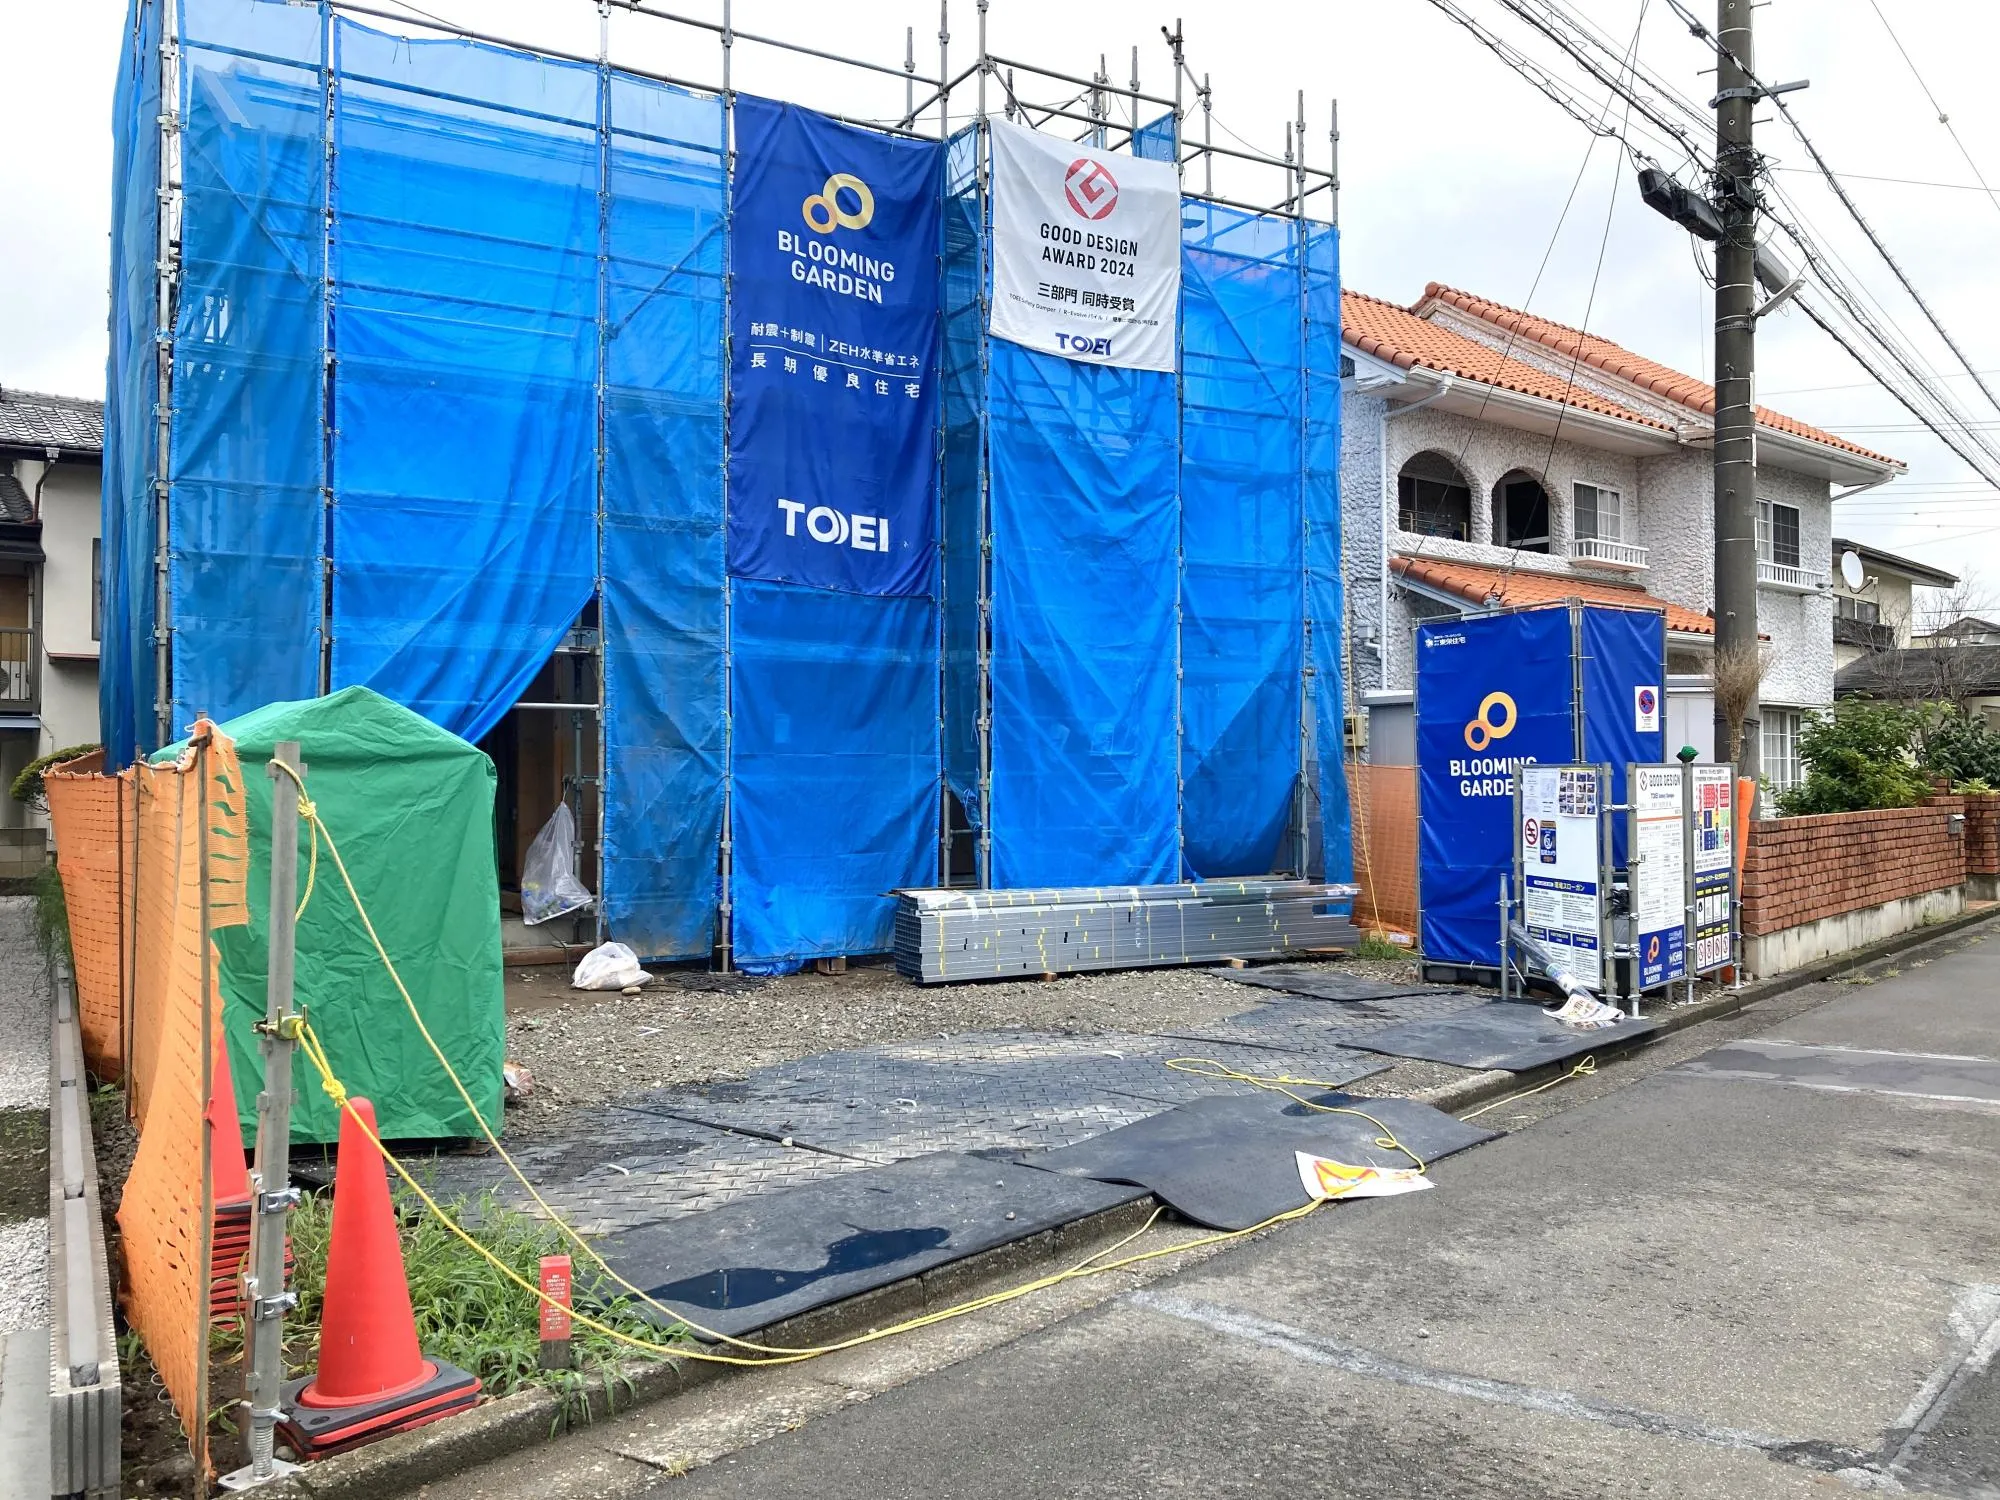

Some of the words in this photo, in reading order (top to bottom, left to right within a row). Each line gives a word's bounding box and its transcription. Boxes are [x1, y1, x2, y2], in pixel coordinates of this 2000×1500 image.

[1040, 223, 1081, 245] GOOD
[1087, 233, 1138, 257] DESIGN
[778, 230, 894, 282] BLOOMING
[1042, 246, 1095, 270] AWARD
[1100, 258, 1134, 277] 2024
[791, 260, 882, 304] GARDEN
[1037, 282, 1077, 304] 三部門
[1082, 291, 1135, 313] 同時受賞
[829, 339, 920, 369] ZEH水準省エネ
[1055, 332, 1111, 356] TOEI
[778, 498, 889, 552] TOEI
[1461, 779, 1523, 797] GARDE
